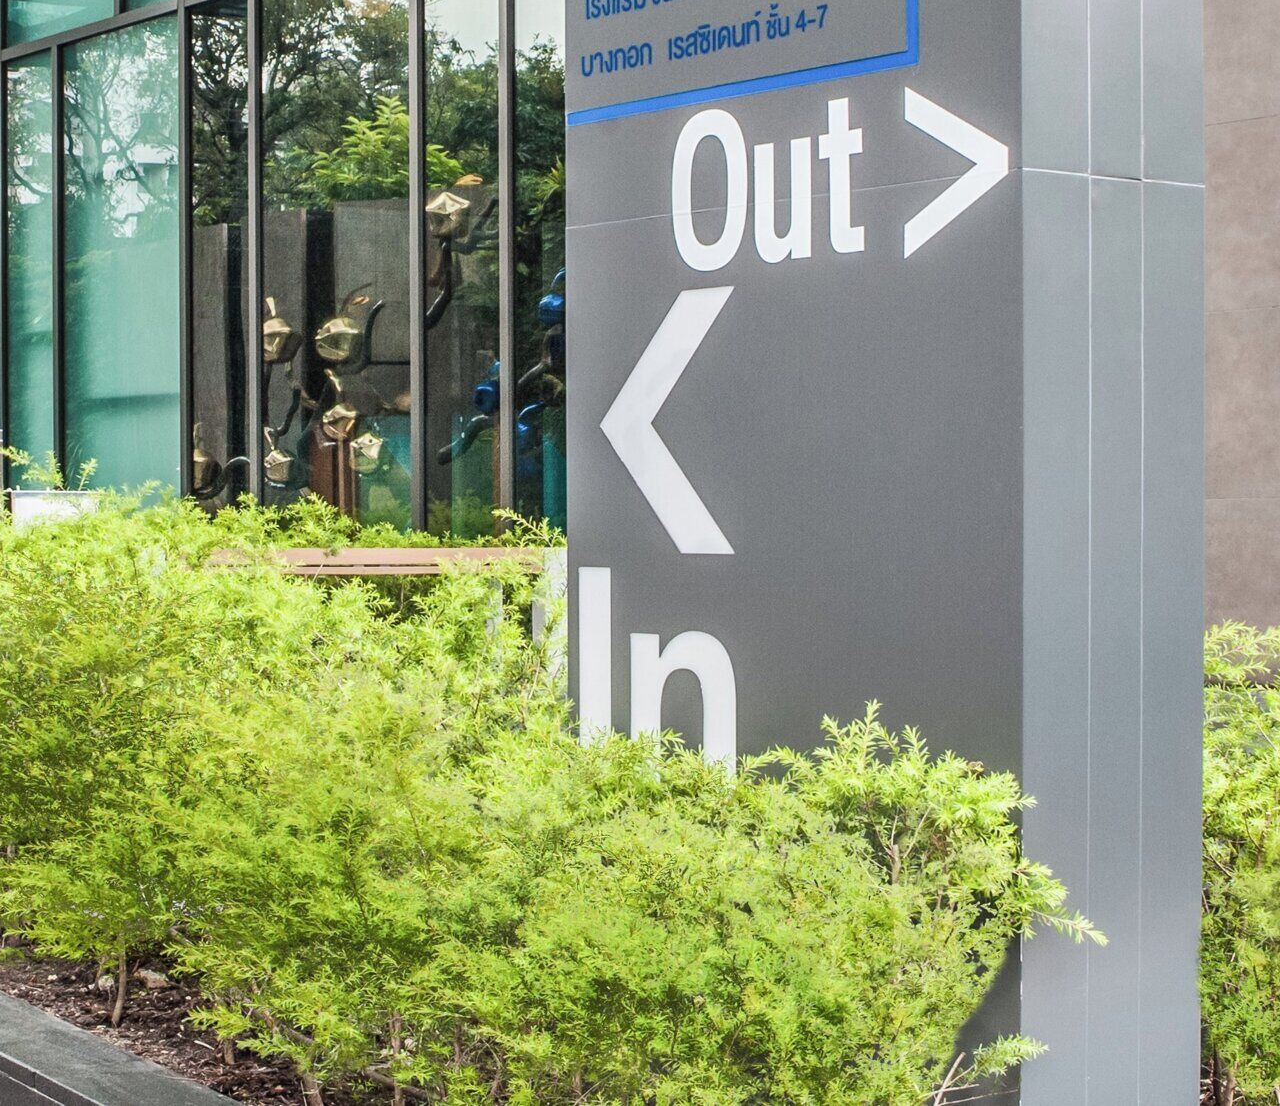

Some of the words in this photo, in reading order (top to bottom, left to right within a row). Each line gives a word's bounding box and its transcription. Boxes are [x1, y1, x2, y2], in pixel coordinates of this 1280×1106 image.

[581, 42, 652, 77] บางกอก
[766, 3, 790, 40] ชั้น
[794, 4, 828, 33] 4-7
[671, 97, 865, 272] Out
[578, 566, 736, 782] In
